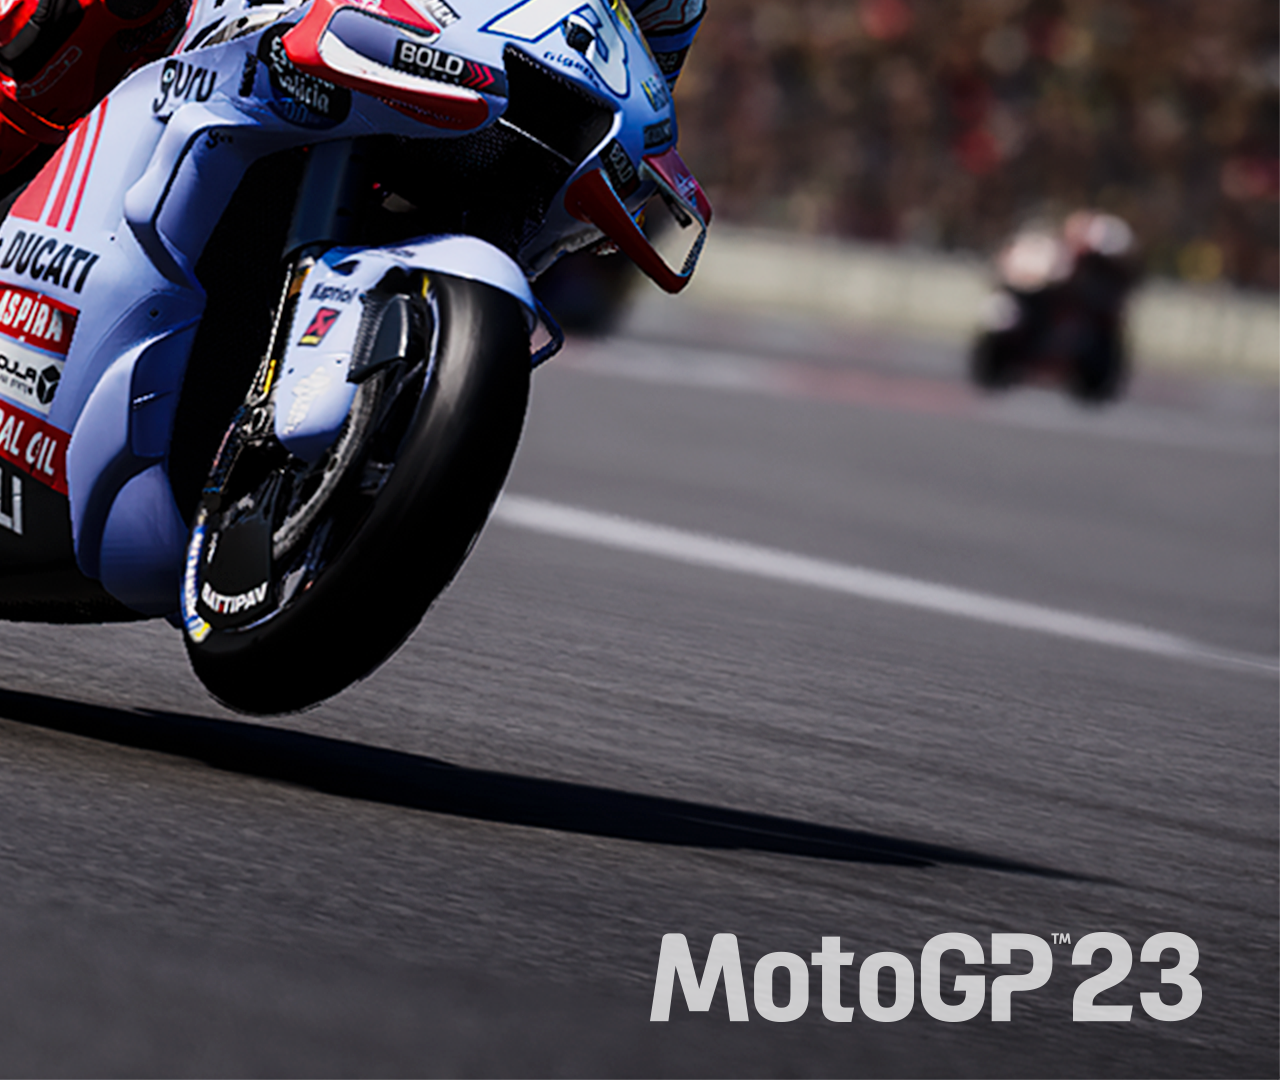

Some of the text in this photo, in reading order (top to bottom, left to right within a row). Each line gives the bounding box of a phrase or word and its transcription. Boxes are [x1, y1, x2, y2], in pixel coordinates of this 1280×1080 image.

[400, 42, 464, 76] BOLD
[0, 230, 100, 294] DUCATI
[25, 432, 57, 476] OIL
